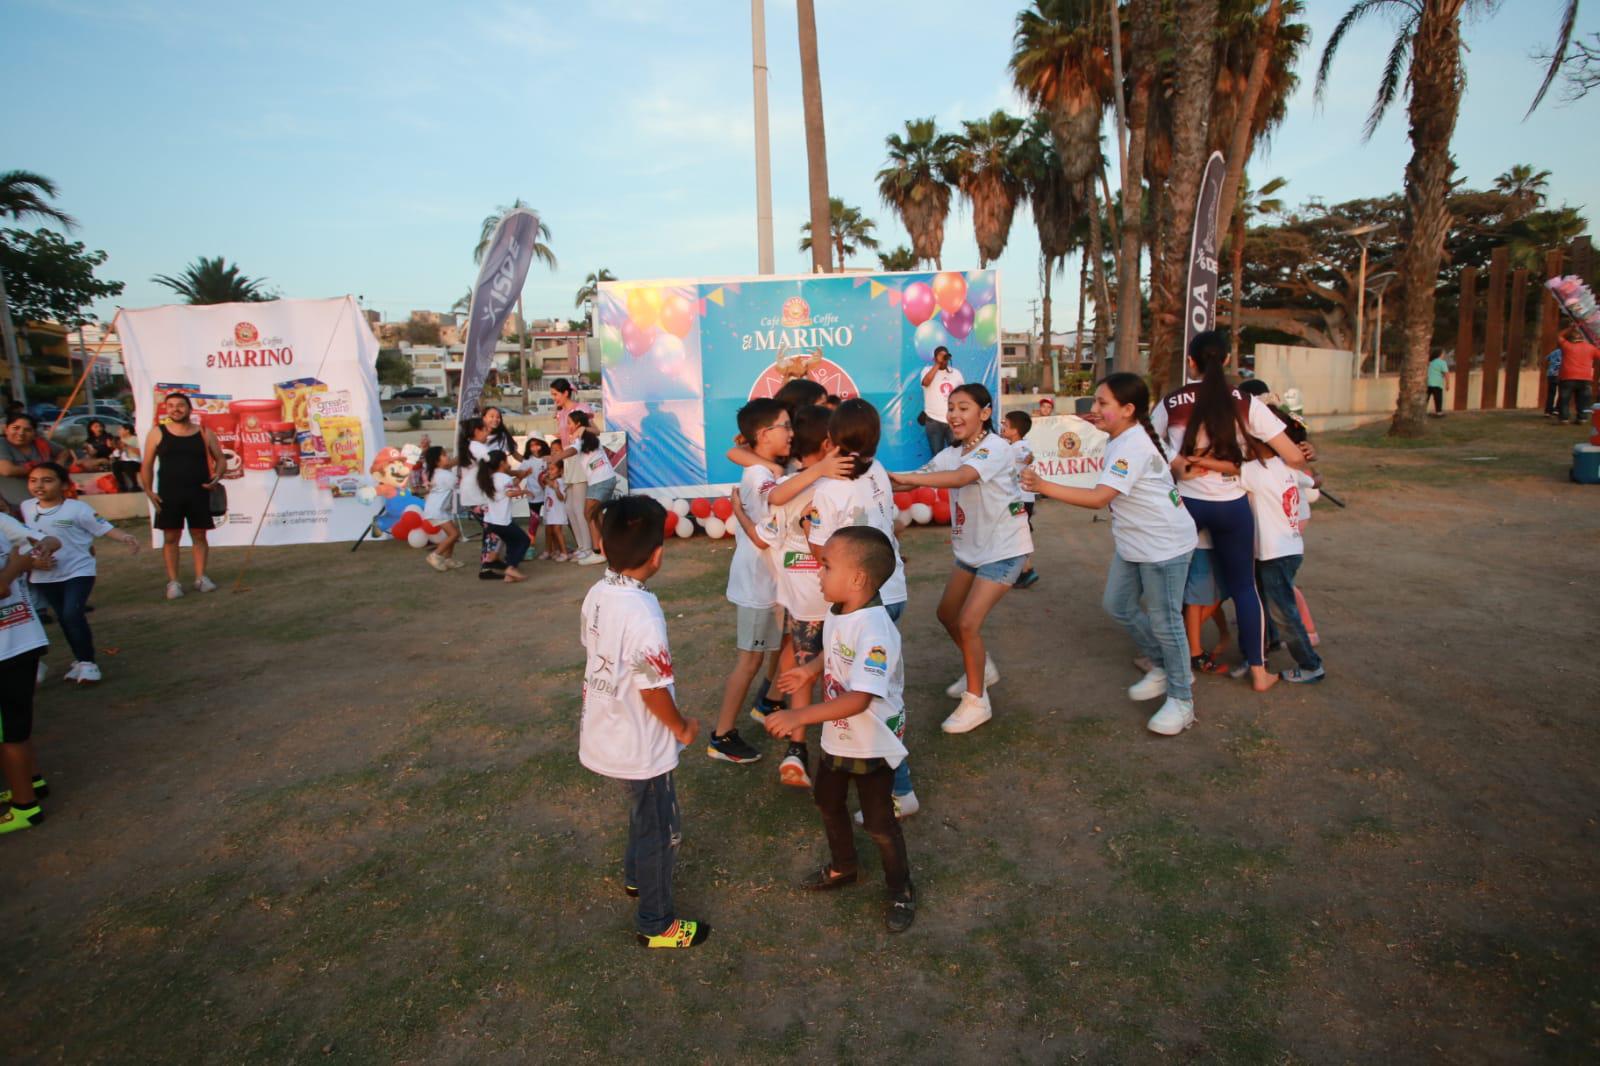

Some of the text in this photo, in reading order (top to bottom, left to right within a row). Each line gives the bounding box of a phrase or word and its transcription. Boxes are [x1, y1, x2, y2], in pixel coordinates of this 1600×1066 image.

[813, 314, 838, 326] Coffee
[754, 326, 853, 350] MARINO
[217, 346, 293, 369] MARINO
